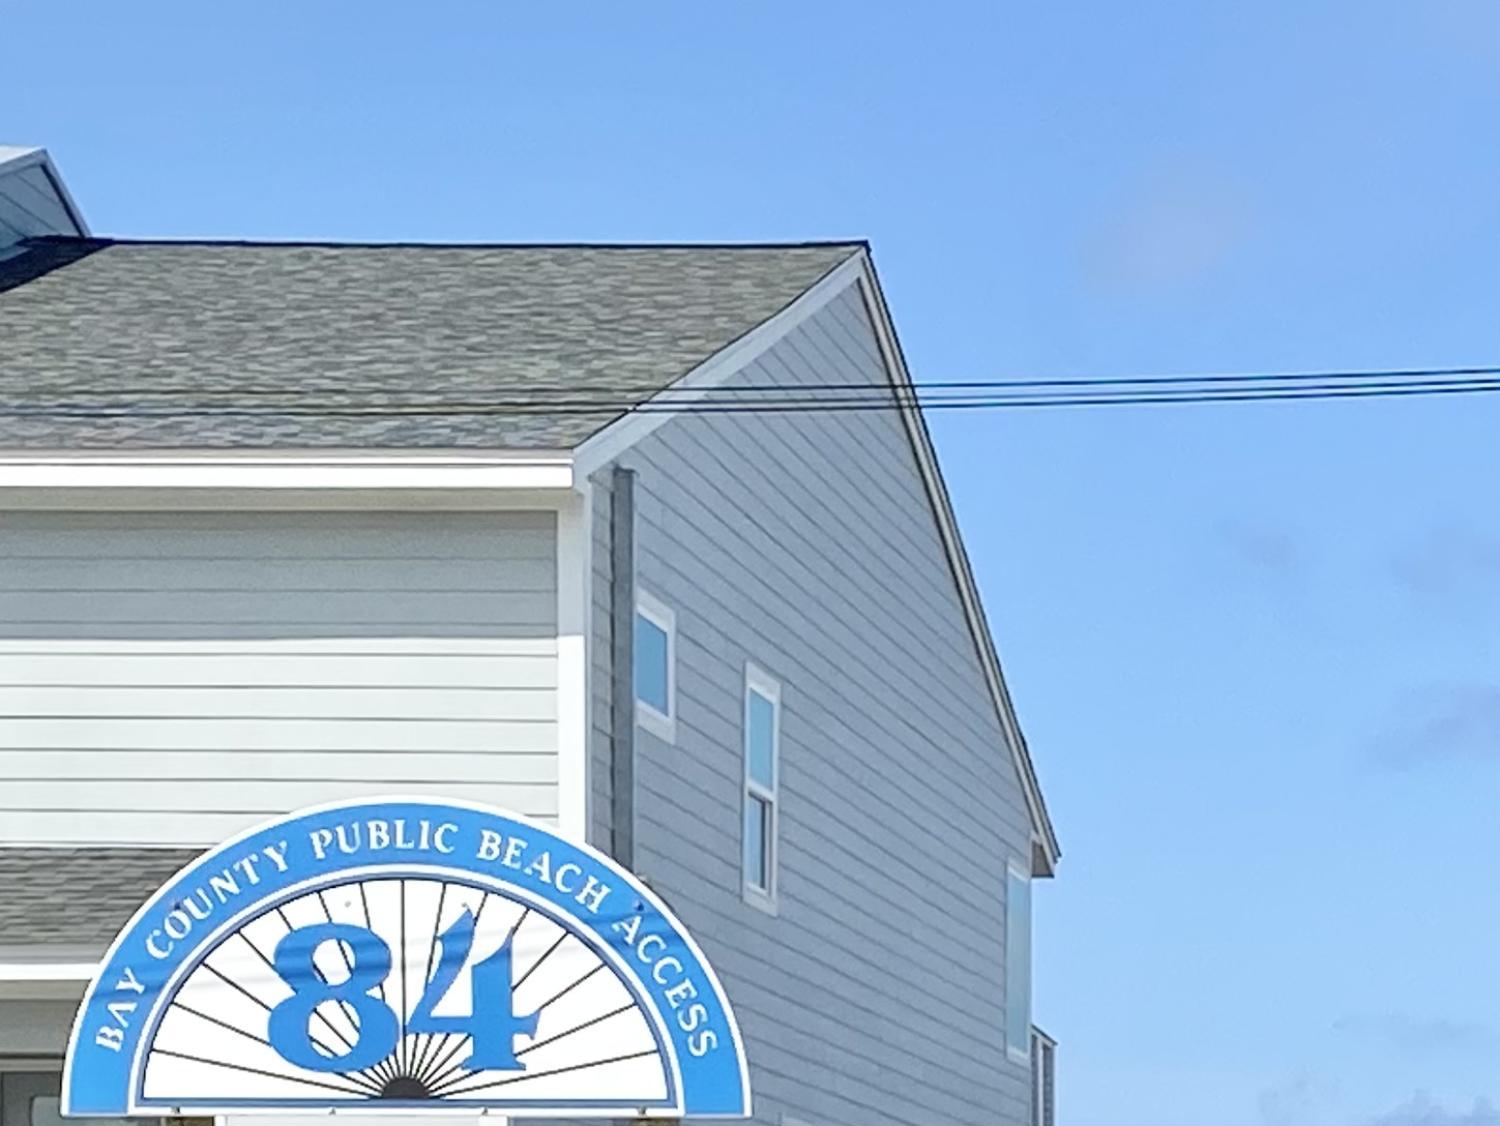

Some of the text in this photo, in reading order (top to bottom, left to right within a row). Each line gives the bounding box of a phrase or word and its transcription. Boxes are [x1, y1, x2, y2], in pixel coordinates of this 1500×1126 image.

[95, 819, 719, 1059] BAY COUNTY PUBLIC BEACH ACCESS
[268, 908, 541, 1073] 84
